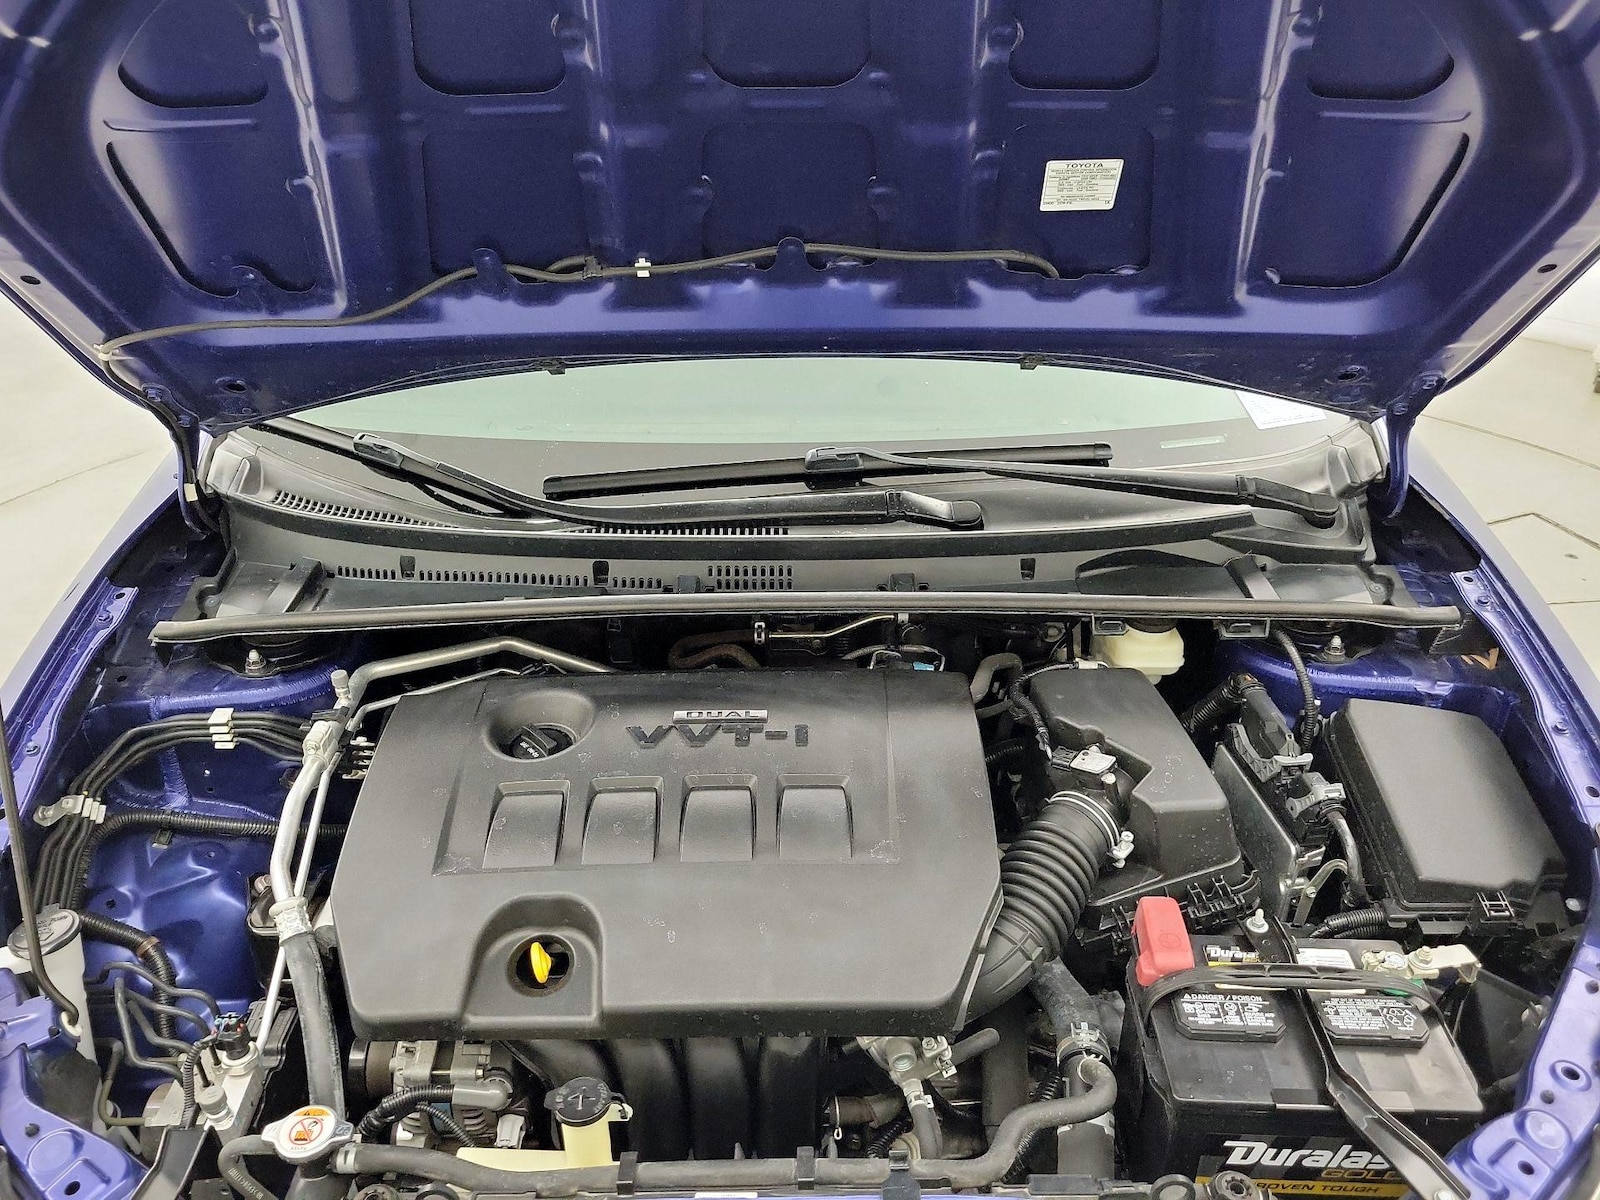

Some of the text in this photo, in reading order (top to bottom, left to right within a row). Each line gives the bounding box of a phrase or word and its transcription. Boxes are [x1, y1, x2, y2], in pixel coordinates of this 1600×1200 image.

[686, 710, 759, 718] DUAL
[1191, 993, 1225, 1001] DANGER
[1222, 1140, 1390, 1169] Duralas
[1255, 1182, 1380, 1193] ROVEN TOUGH
